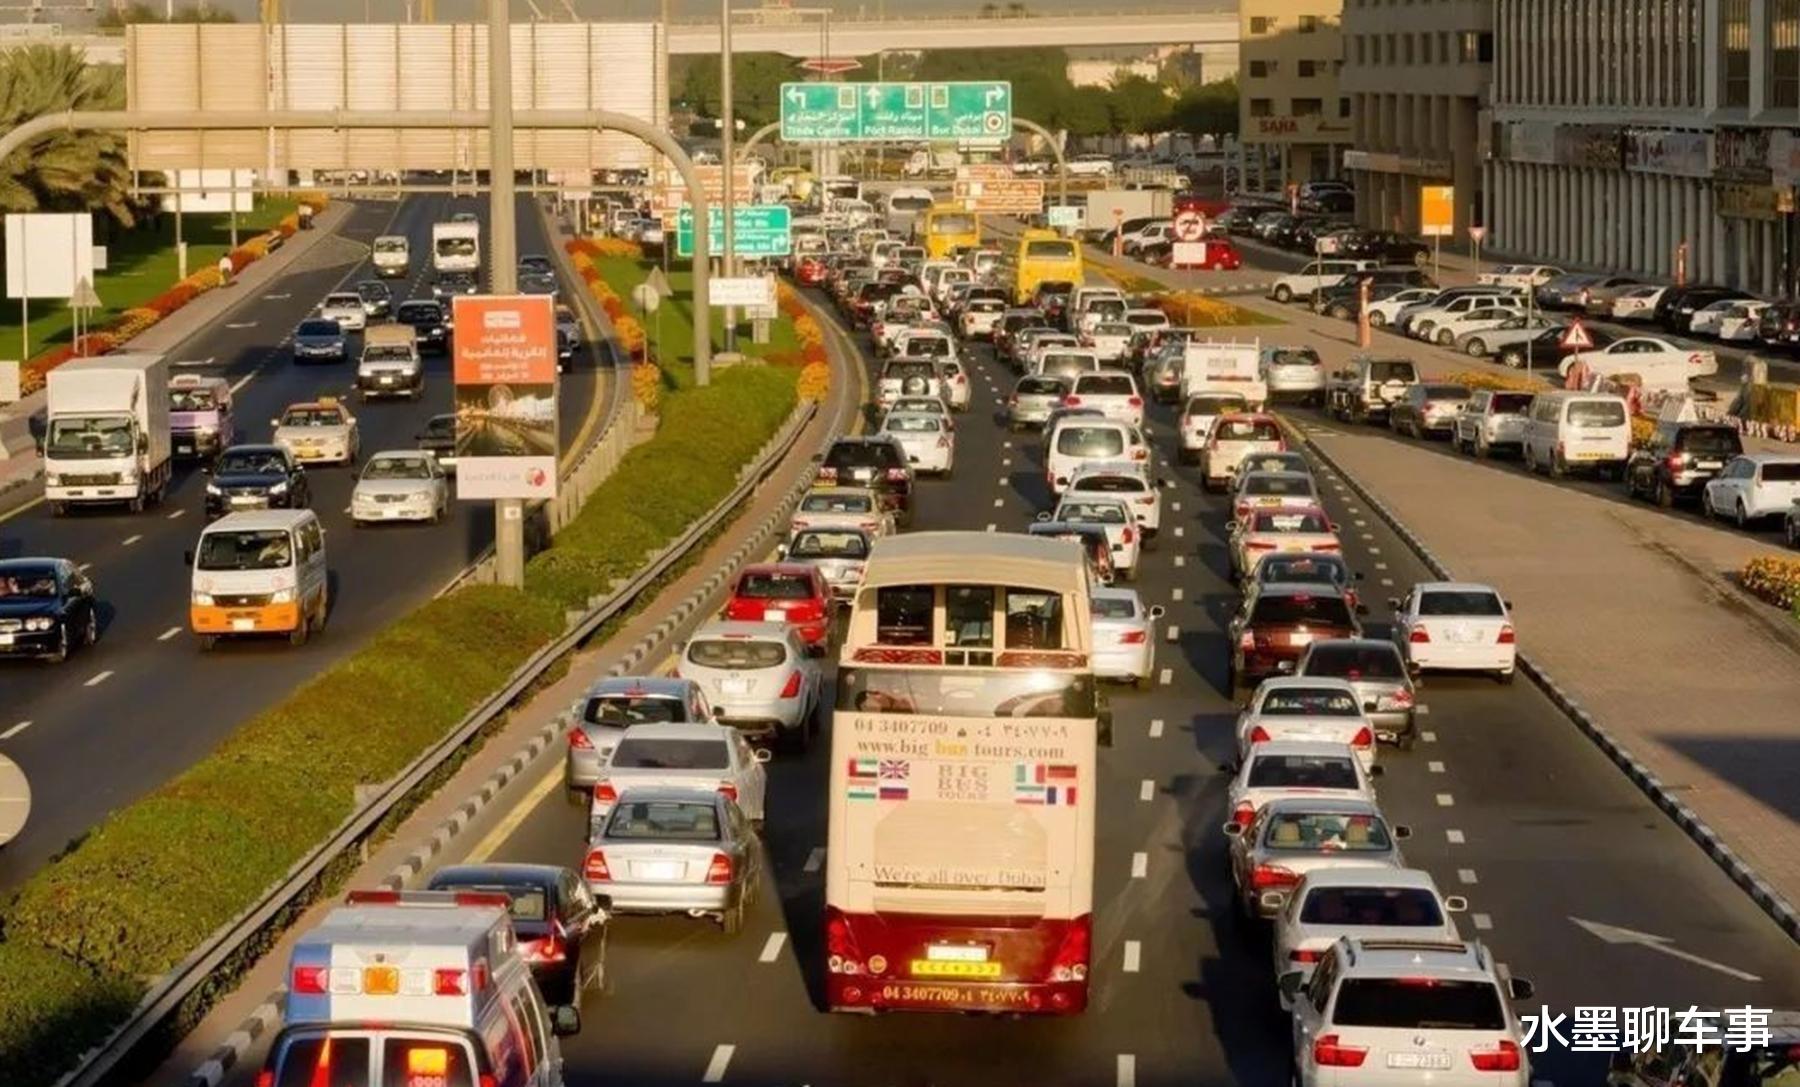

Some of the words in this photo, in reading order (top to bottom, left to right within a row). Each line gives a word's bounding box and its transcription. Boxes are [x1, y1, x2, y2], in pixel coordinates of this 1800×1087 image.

[864, 126, 885, 136] Port
[931, 125, 950, 135] Bur
[855, 719, 873, 731] 04
[879, 719, 948, 734] 3407709
[857, 739, 928, 756] www.big
[935, 739, 968, 756] bus
[974, 740, 1065, 759] tours.com
[938, 764, 989, 779] BIG
[938, 778, 989, 791] BUS
[874, 866, 921, 881] We're
[928, 868, 949, 882] all
[954, 871, 990, 883] over
[882, 985, 900, 1000] 04
[902, 986, 959, 1001] 3407709
